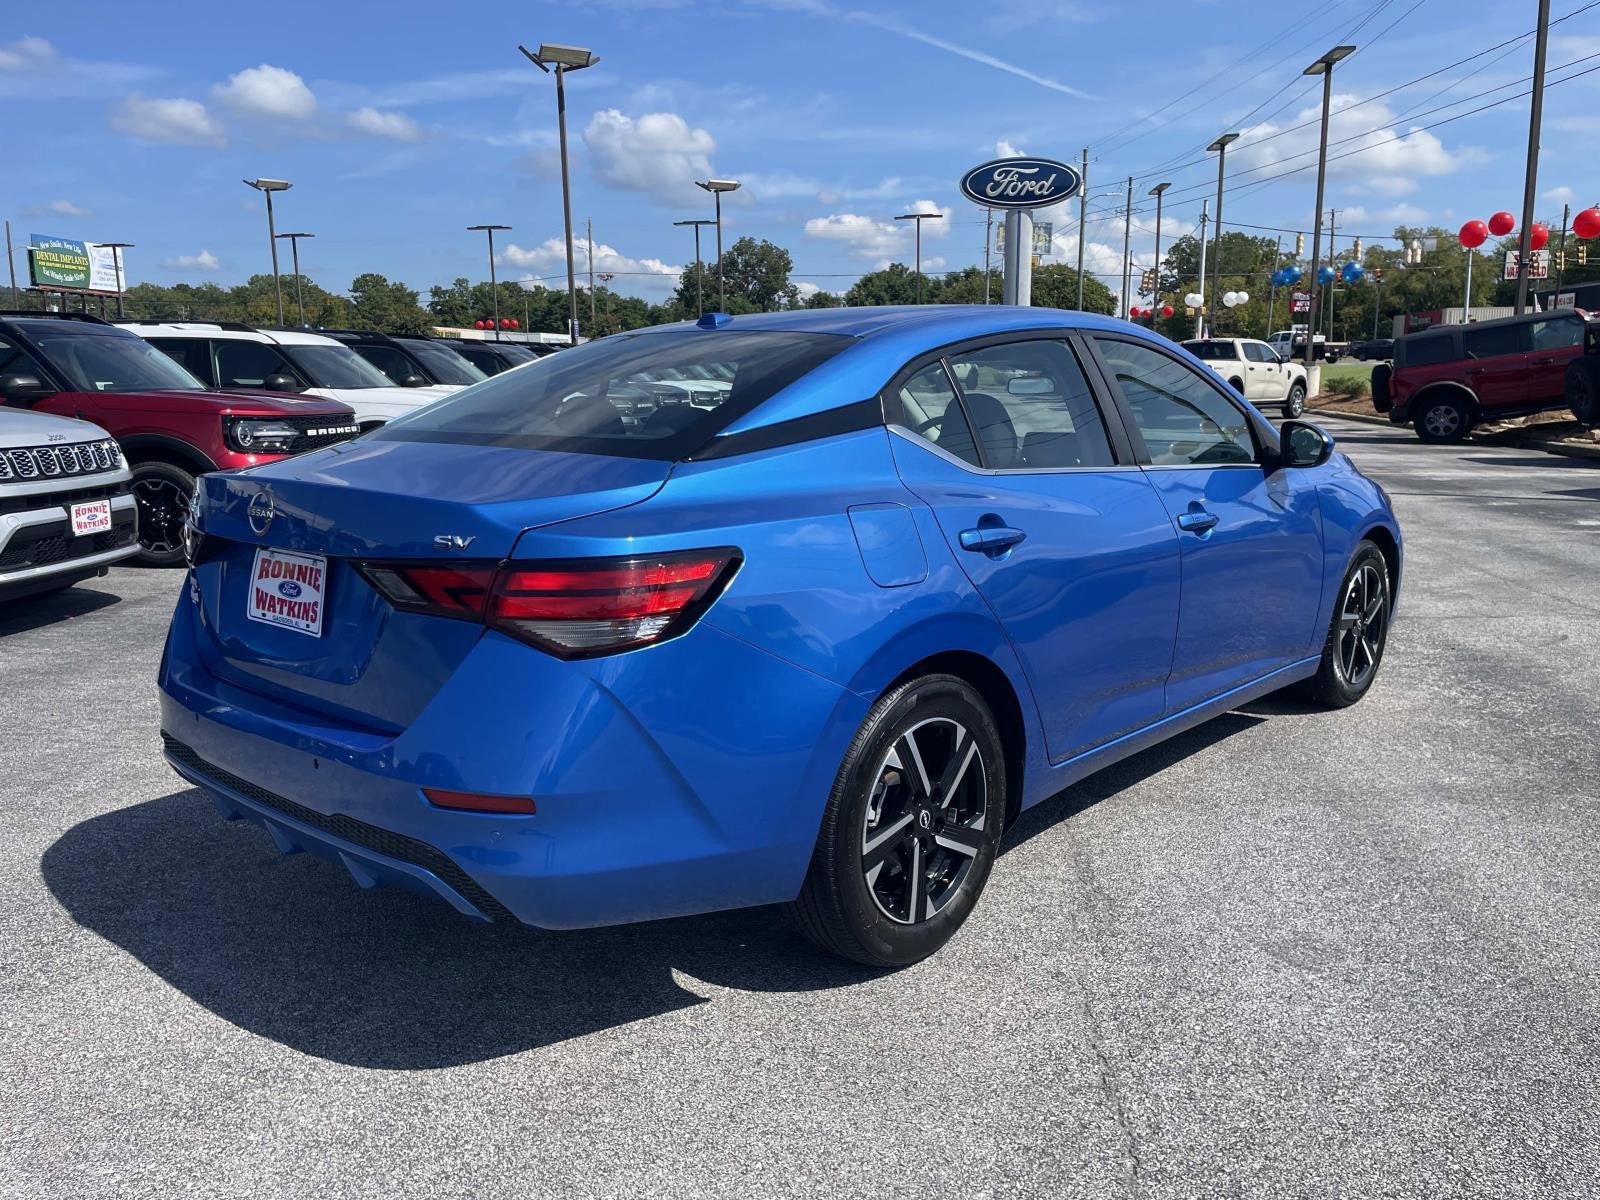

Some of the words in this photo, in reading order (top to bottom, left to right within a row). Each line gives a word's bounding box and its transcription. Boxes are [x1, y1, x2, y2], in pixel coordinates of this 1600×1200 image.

[985, 167, 1057, 197] Ford
[36, 250, 60, 261] DENTAL
[60, 254, 88, 266] IMPLANTS
[306, 426, 358, 436] BRONCO
[75, 504, 108, 518] RONNIE
[76, 516, 109, 530] WATKINS
[433, 535, 476, 550] SV
[258, 558, 321, 592] RONNIE
[256, 587, 318, 623] WATKINS
